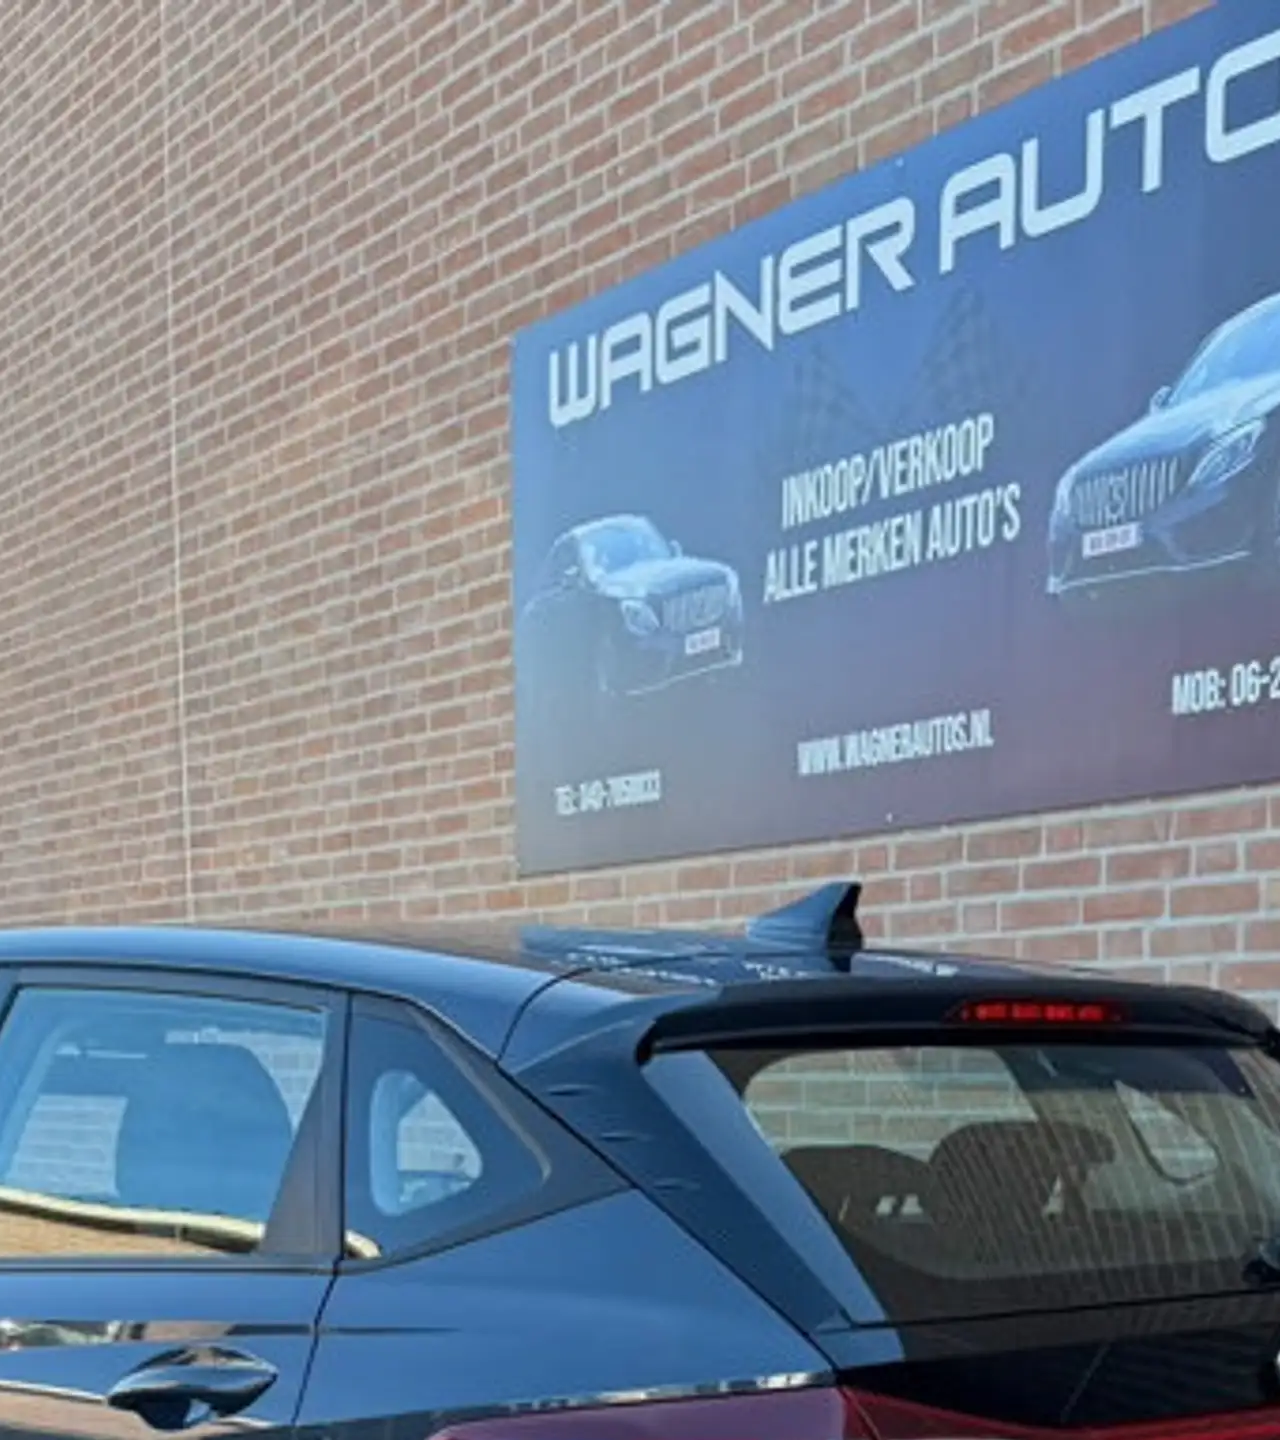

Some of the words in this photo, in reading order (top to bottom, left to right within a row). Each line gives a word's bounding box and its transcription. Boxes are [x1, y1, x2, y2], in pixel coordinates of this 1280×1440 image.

[547, 197, 915, 426] WAGNER
[781, 412, 995, 530] INKOOP/VERKOOP
[764, 540, 818, 603] ALLE
[822, 510, 923, 588] MERKEN
[927, 481, 1022, 562] AUTO'S
[1172, 670, 1227, 715] MOB:
